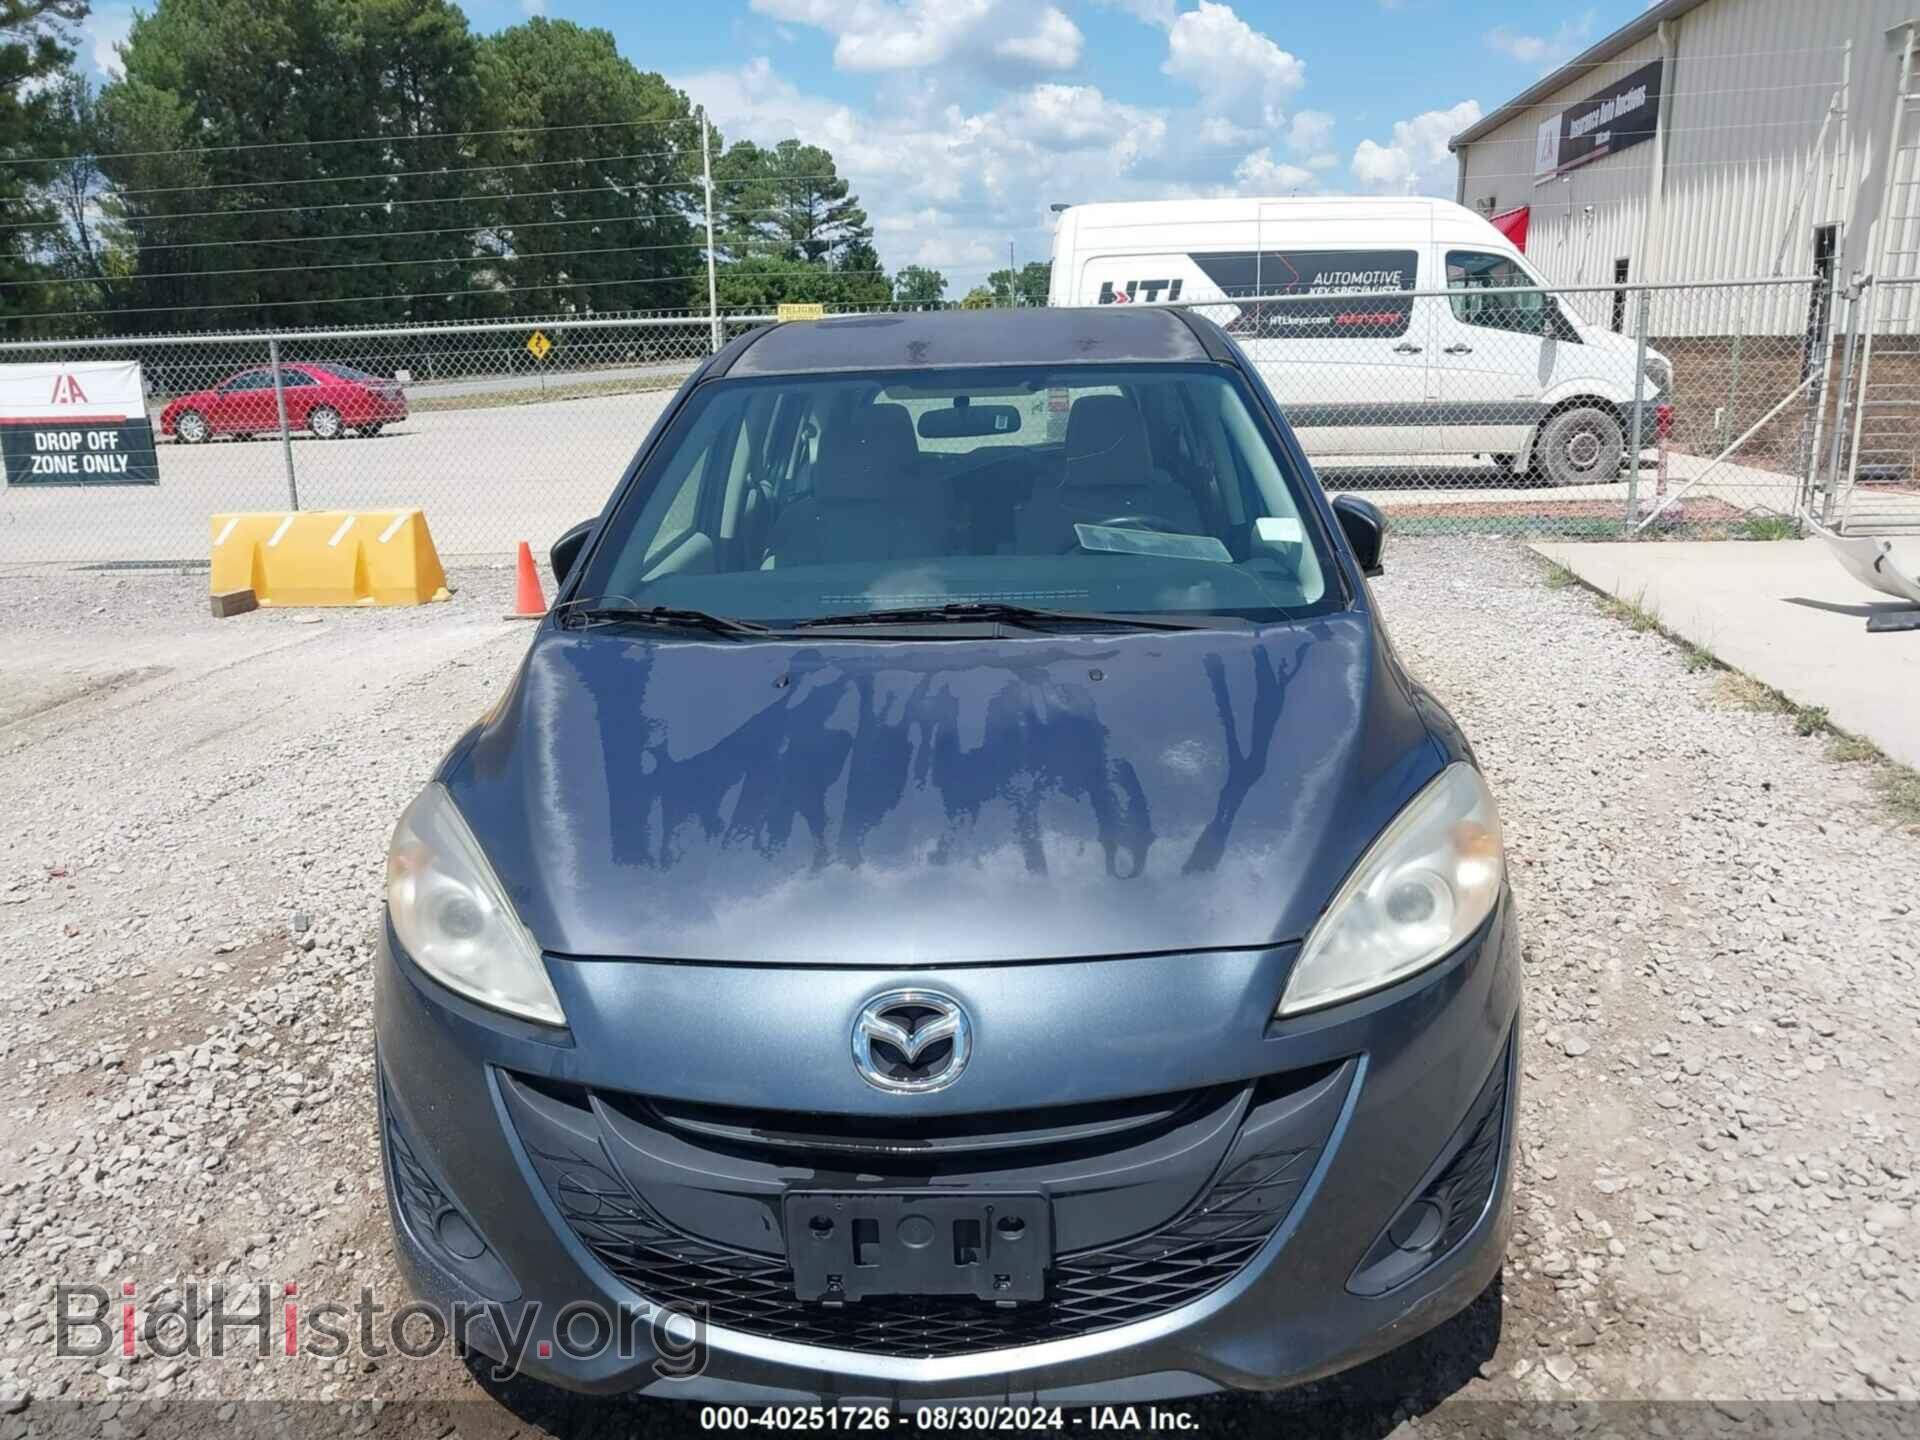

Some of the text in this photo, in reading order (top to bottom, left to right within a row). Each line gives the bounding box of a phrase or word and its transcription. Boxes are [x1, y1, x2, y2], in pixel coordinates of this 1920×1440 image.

[1312, 270, 1402, 285] AUTOMOTIVE
[34, 431, 119, 451] DROP OFF
[31, 454, 128, 474] ZONE ONLY
